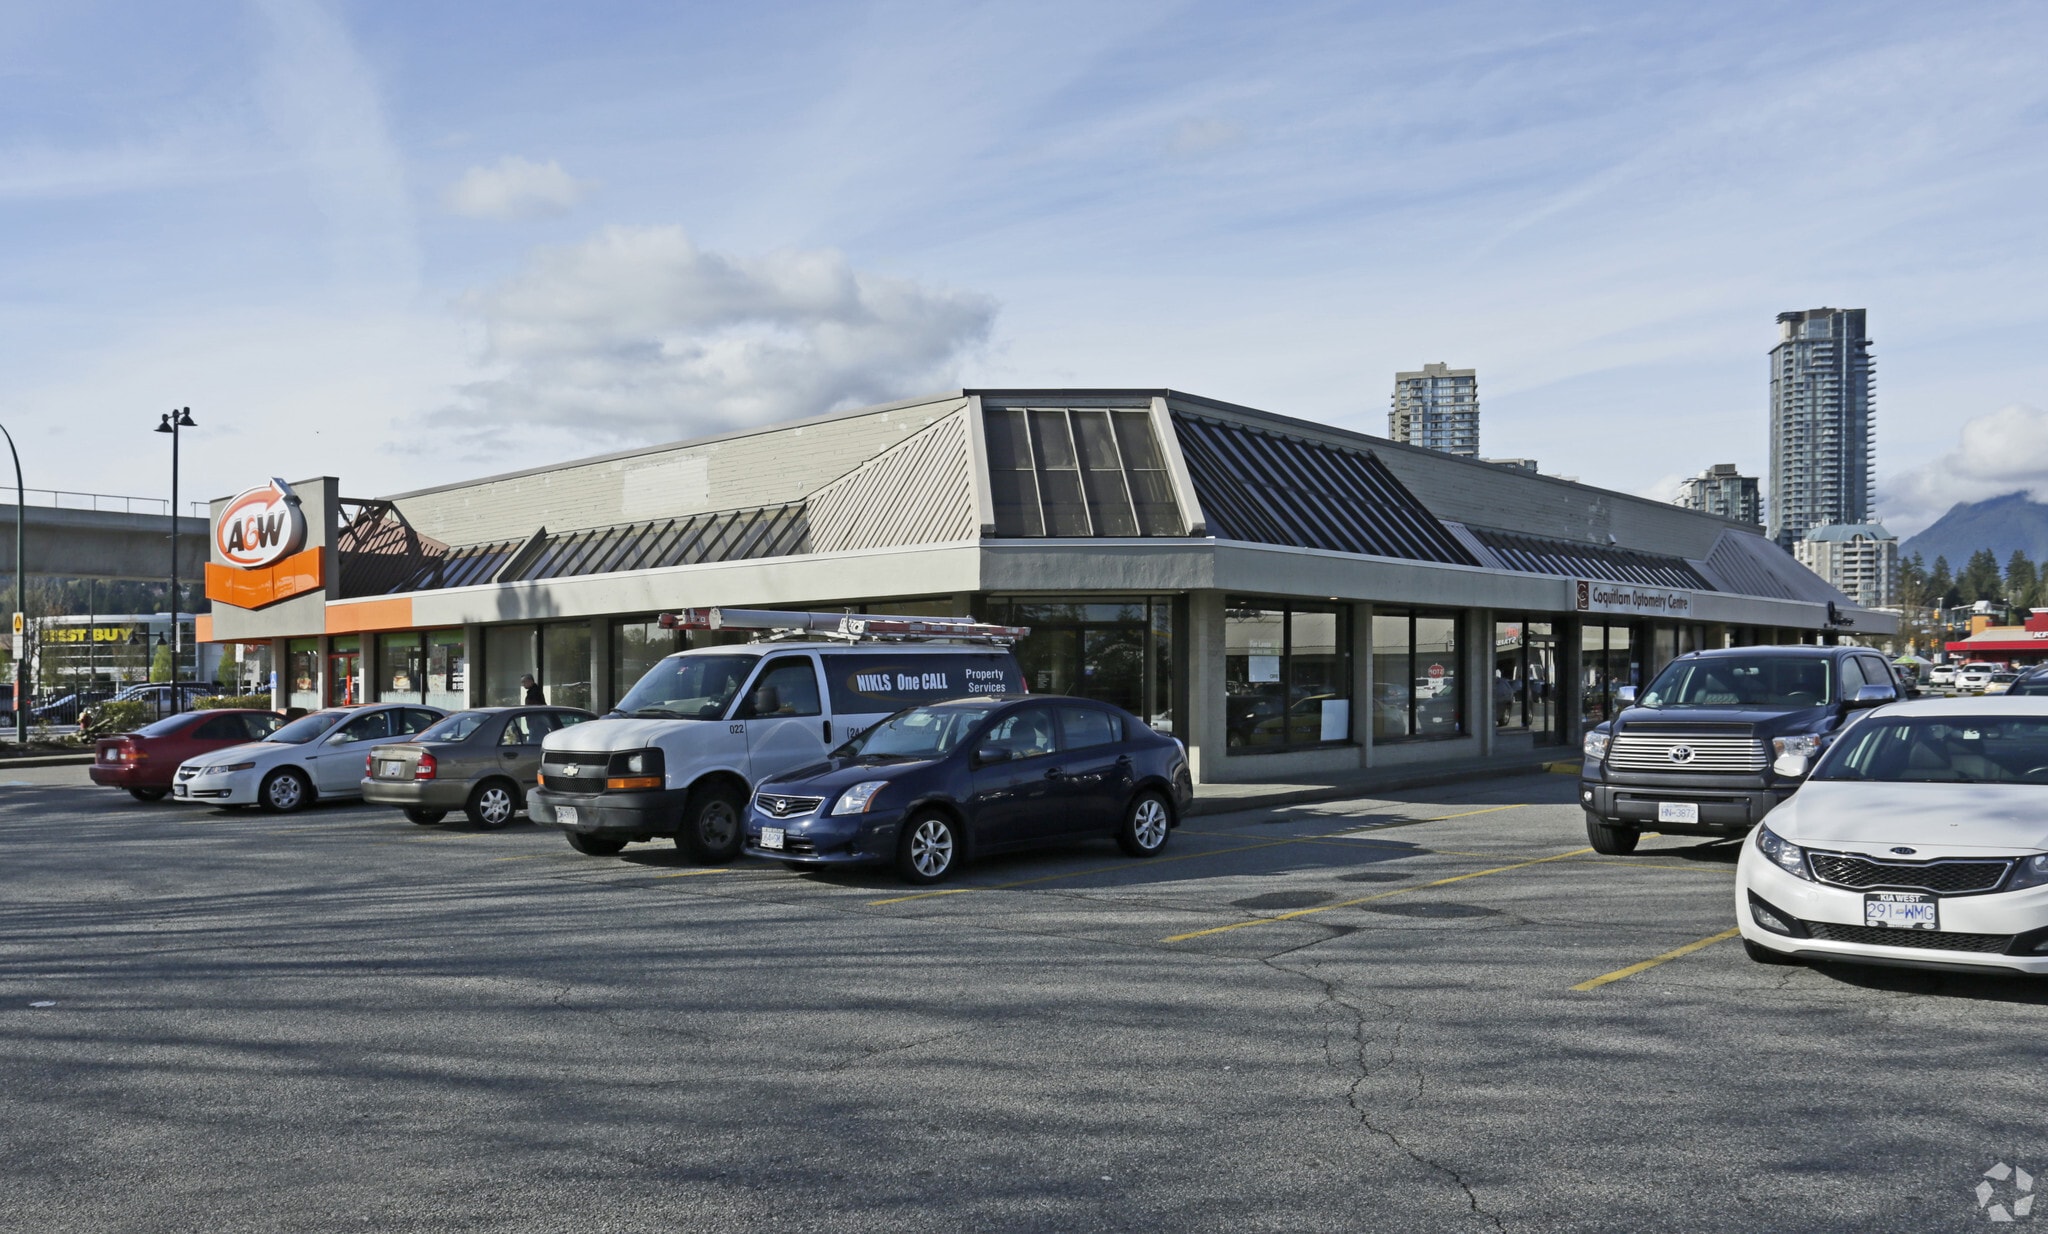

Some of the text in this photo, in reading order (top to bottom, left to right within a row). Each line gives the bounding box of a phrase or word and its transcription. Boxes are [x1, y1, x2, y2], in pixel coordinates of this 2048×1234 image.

[227, 509, 286, 553] A&W
[1593, 586, 1688, 612] Coquitlam Optometry Centre
[92, 627, 133, 642] BUY
[965, 668, 1004, 681] Property
[856, 673, 948, 692] NIKLS One CALL
[968, 682, 1006, 693] Services
[729, 724, 744, 735] 022
[1880, 894, 1896, 902] KIA
